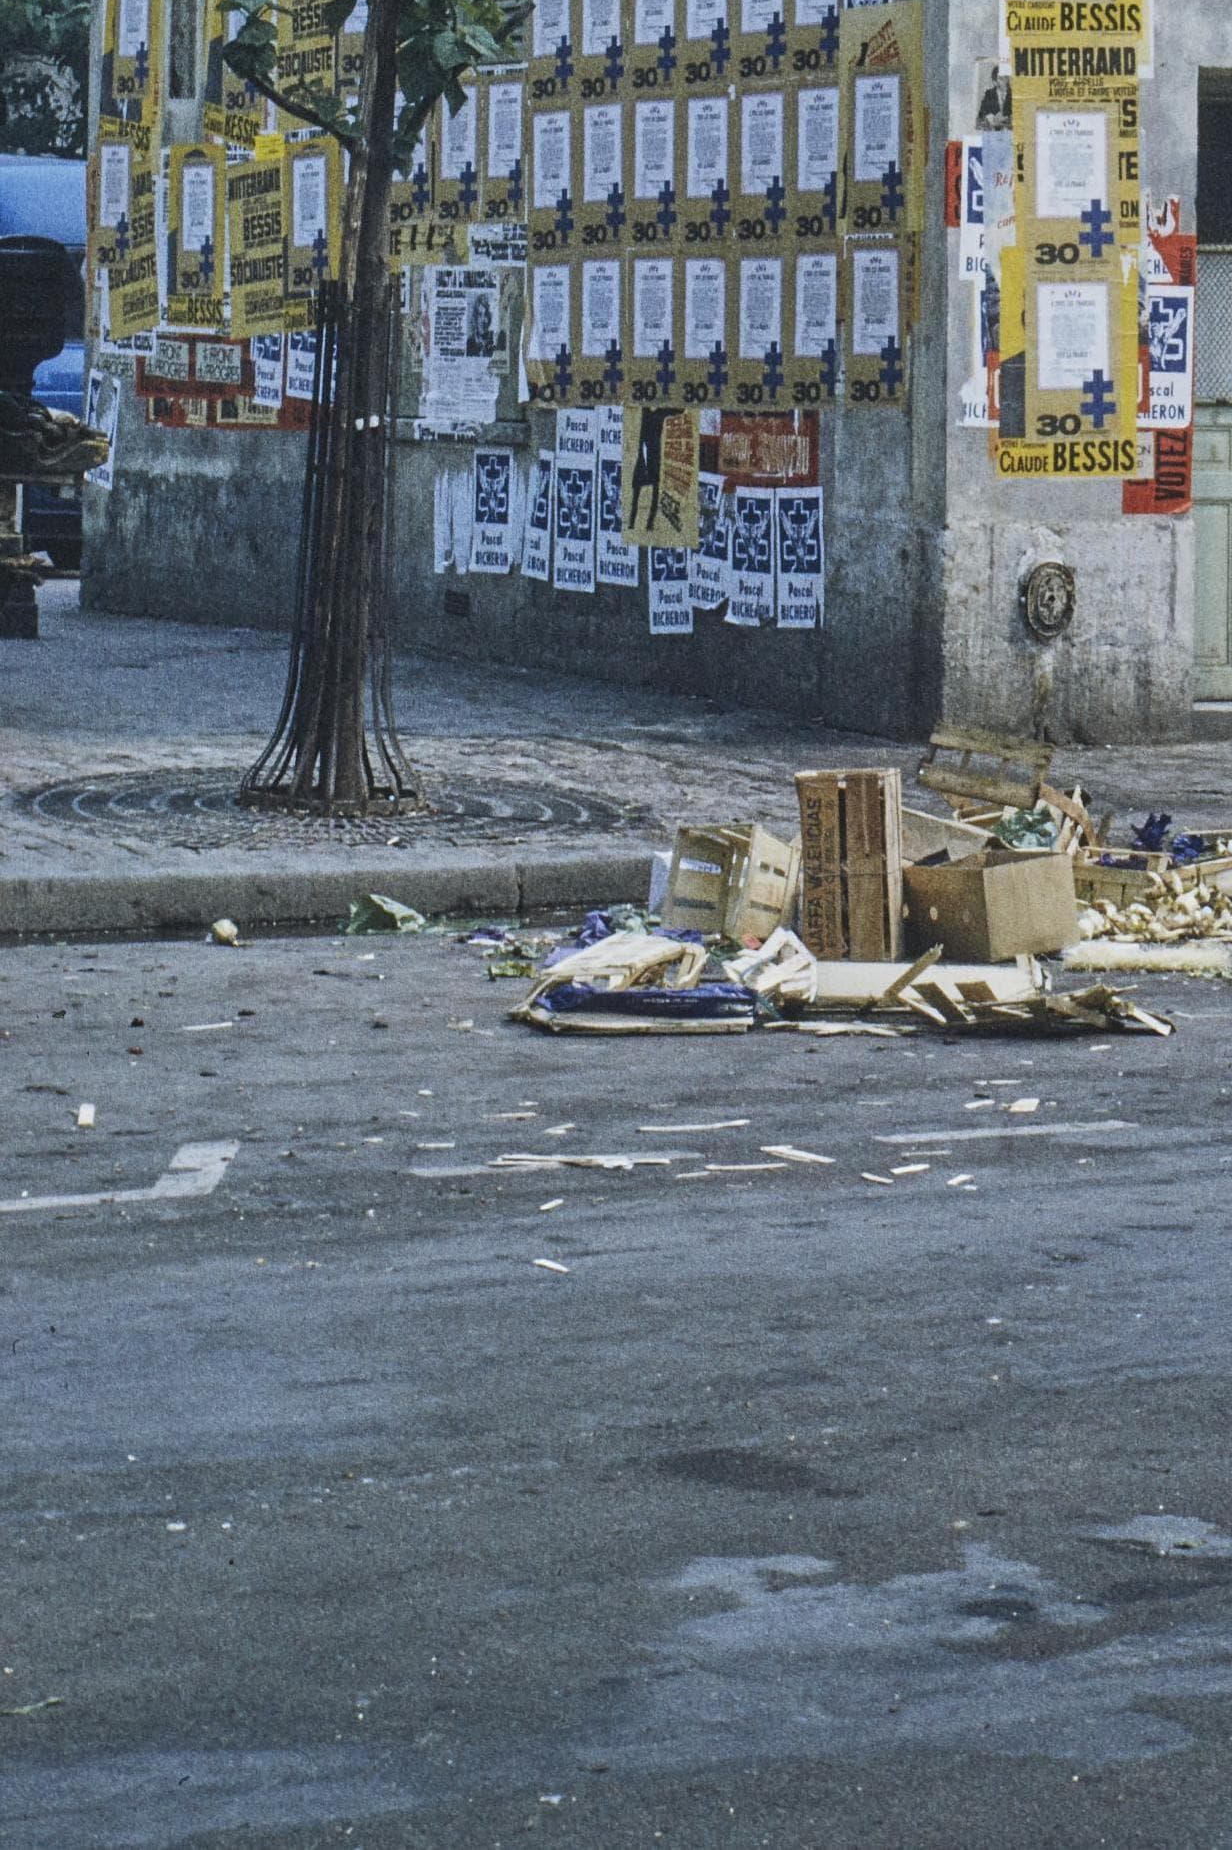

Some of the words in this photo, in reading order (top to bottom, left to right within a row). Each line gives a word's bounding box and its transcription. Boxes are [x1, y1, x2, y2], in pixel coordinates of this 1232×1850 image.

[1007, 11, 1056, 31] CLAUDE
[1061, 2, 1141, 32] BESSIS
[740, 56, 766, 78] 30
[793, 49, 820, 71] 30
[1014, 47, 1136, 76] MITTERRAND
[633, 67, 658, 88] 30
[685, 62, 711, 84] 30
[533, 78, 556, 99] 30
[581, 78, 605, 98] 30
[225, 92, 245, 109] 30
[439, 200, 459, 218] 30
[485, 199, 508, 218] 30
[853, 206, 881, 228] 30
[582, 224, 607, 246] 30
[632, 221, 657, 242] 30
[685, 221, 711, 242] 30
[738, 219, 766, 240] 30
[795, 216, 823, 237] 30
[532, 230, 556, 250] 30
[1035, 243, 1079, 265] 30
[293, 267, 313, 286] 30
[580, 380, 604, 399] 30
[632, 380, 657, 400] 30
[683, 382, 708, 402] 30
[736, 383, 763, 404] 30
[793, 381, 821, 402] 30
[851, 380, 880, 401] 30
[1150, 382, 1174, 396] scal
[1036, 414, 1081, 436] 30
[601, 429, 621, 444] BICHE
[1000, 451, 1048, 472] CLAUDE
[1053, 440, 1134, 471] BESSIS
